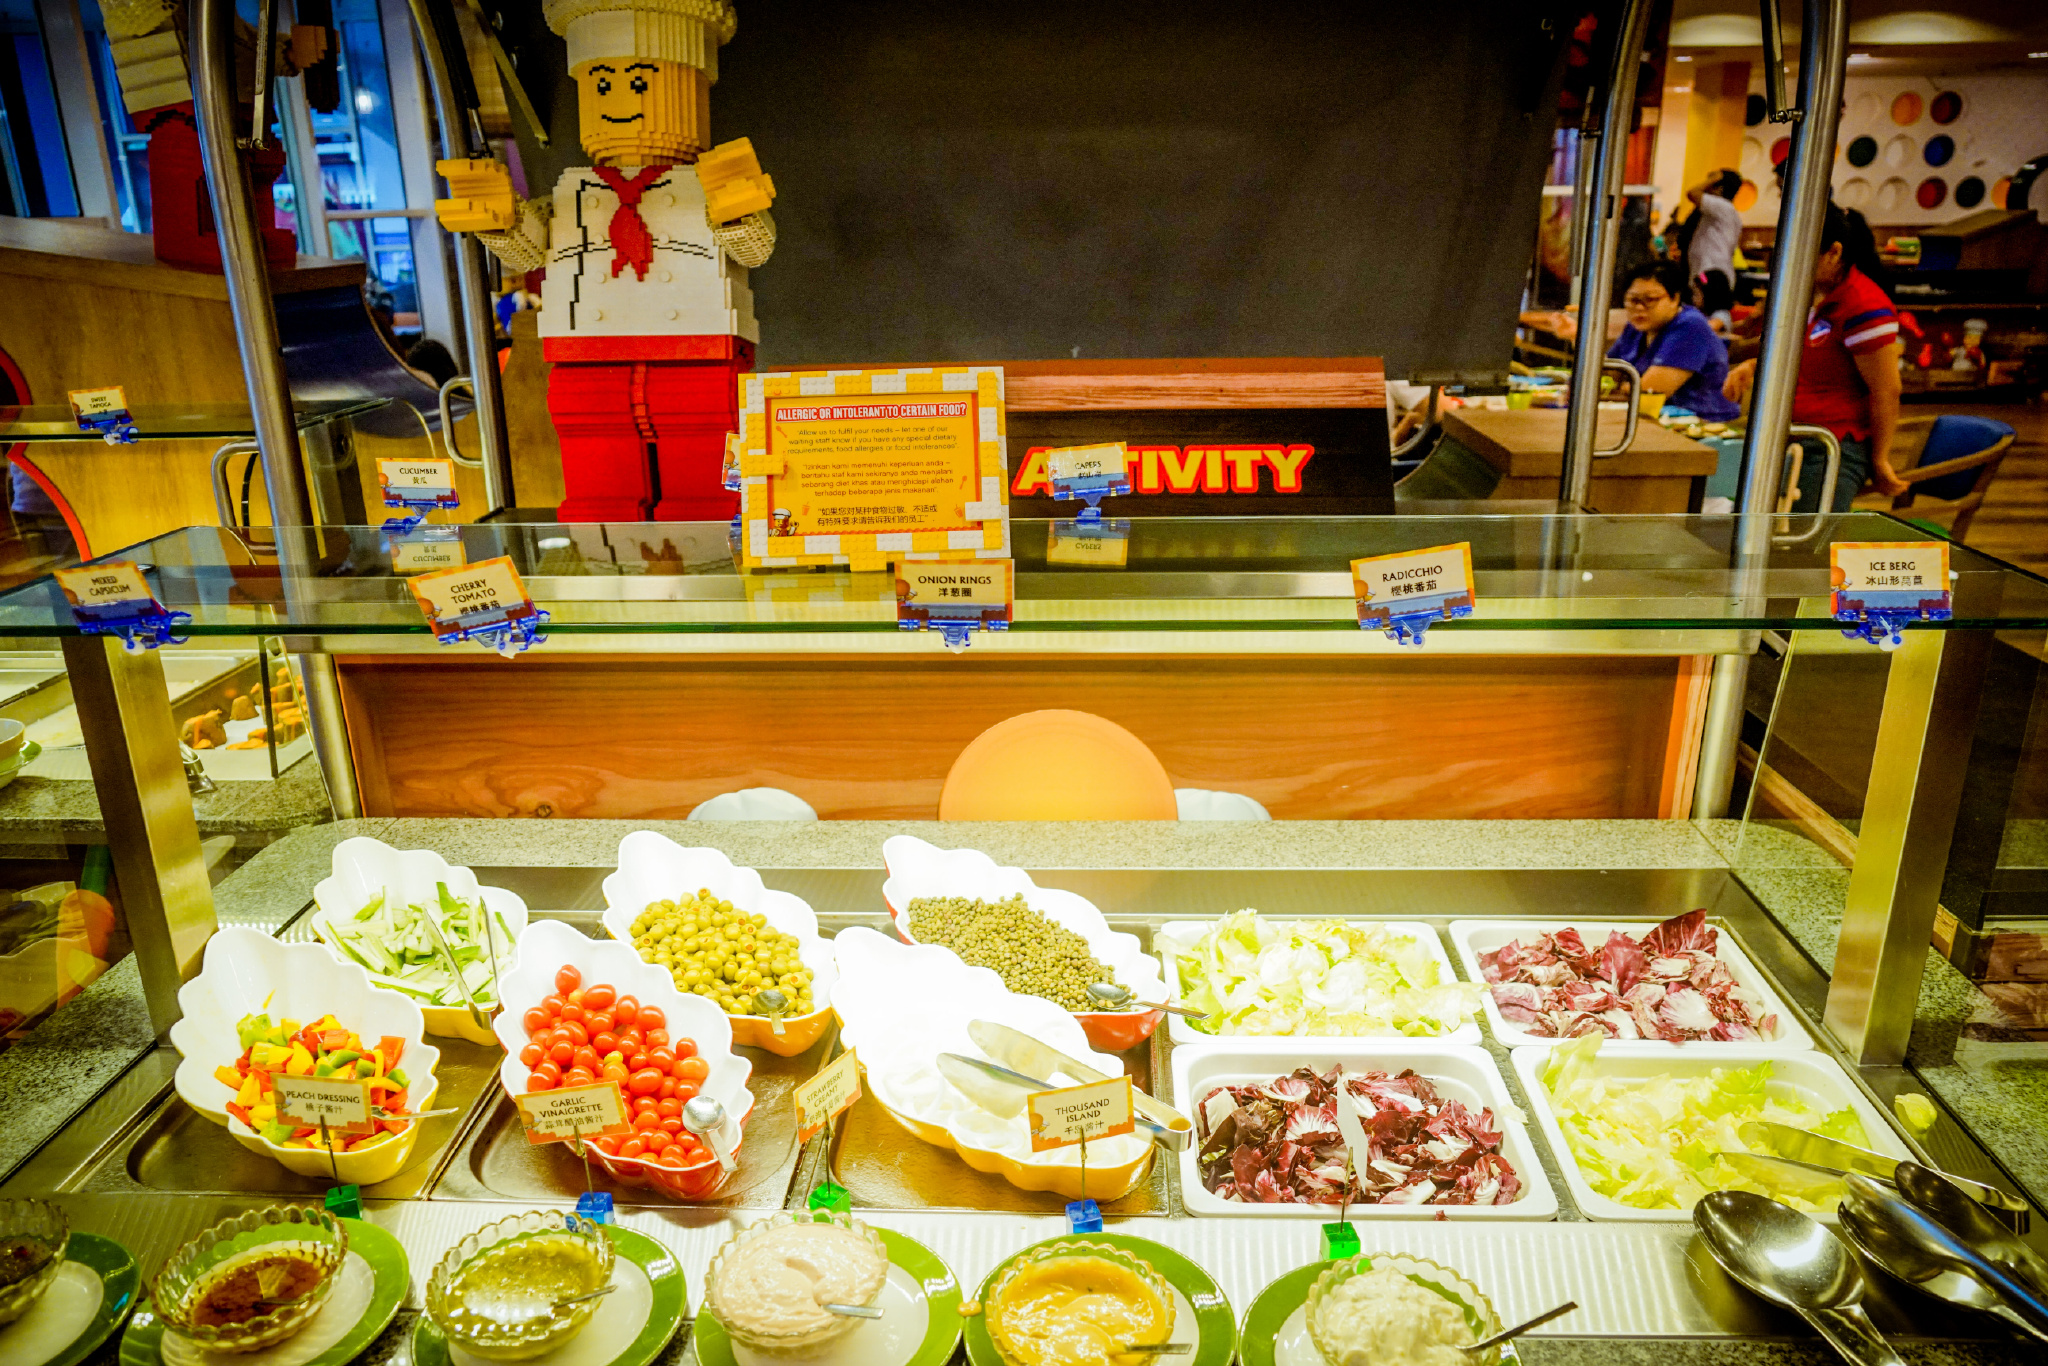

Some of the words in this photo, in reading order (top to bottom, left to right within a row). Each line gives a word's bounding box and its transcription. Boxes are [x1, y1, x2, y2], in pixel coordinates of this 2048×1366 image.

[777, 408, 817, 420] ALLERGIC
[820, 407, 831, 419] OR
[833, 406, 885, 419] INTOLERANT
[887, 406, 898, 417] TO
[901, 404, 936, 416] CERTAIN
[939, 404, 966, 415] FOOD?
[906, 434, 931, 442] special
[855, 445, 884, 453] allergies
[399, 467, 438, 475] CUCUMBER
[1014, 446, 1312, 491] AIVITY
[1074, 461, 1102, 470] CAPERS
[865, 469, 898, 477] sekiranya
[887, 478, 929, 486] menghidapi
[848, 488, 882, 496] beberapa
[1869, 562, 1886, 571] ICE
[1889, 562, 1916, 571] BERG
[918, 575, 957, 584] ONION
[960, 576, 992, 584] RINGS
[1382, 565, 1443, 582] RADICCHIO
[91, 576, 118, 585] MIXED
[450, 579, 487, 594] CHERRY
[89, 585, 131, 596] CAPSICUM
[451, 587, 496, 604] TOMATO
[806, 1069, 844, 1103] STRAWBERRY
[286, 1090, 316, 1100] PEACH
[317, 1093, 360, 1104] DRESSING
[550, 1096, 586, 1108] GARLIC
[814, 1085, 838, 1108] CREAMY
[539, 1103, 603, 1118] VINAIGRETTE
[1055, 1098, 1110, 1115] THOUSAND
[1066, 1110, 1101, 1123] ISLAND
